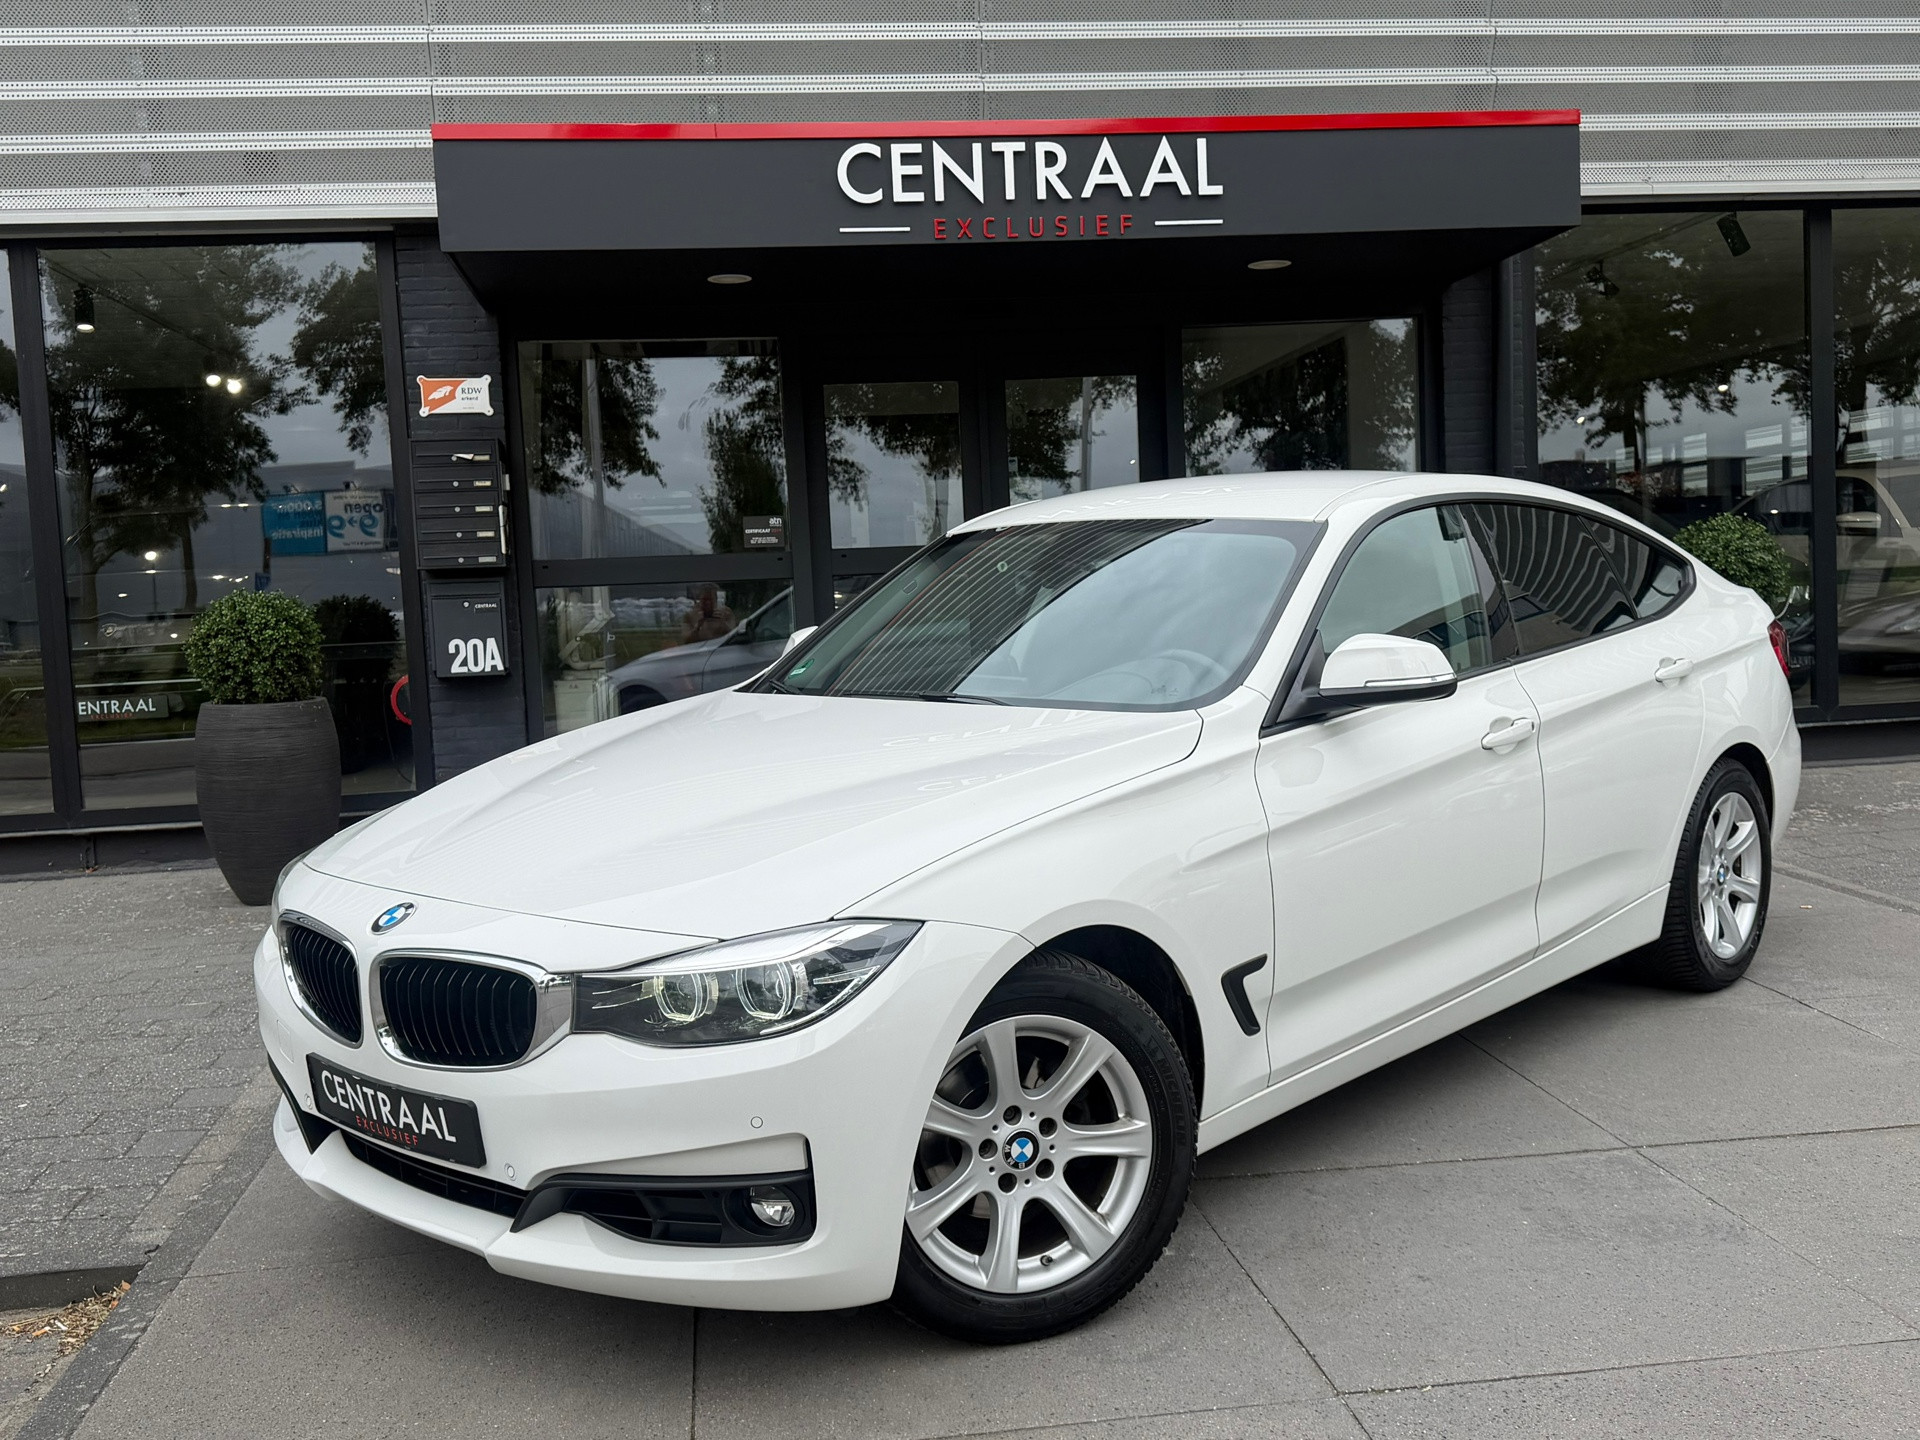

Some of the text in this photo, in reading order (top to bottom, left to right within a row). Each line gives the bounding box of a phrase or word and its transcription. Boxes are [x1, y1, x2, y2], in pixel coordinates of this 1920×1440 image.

[837, 135, 1224, 204] CENTRAAL
[934, 214, 1134, 239] EXCLUSIEF
[461, 386, 483, 395] RDW
[448, 637, 504, 674] 20A
[321, 1070, 457, 1143] CENTRAAL
[356, 1115, 419, 1145] EXCLUSIEF
